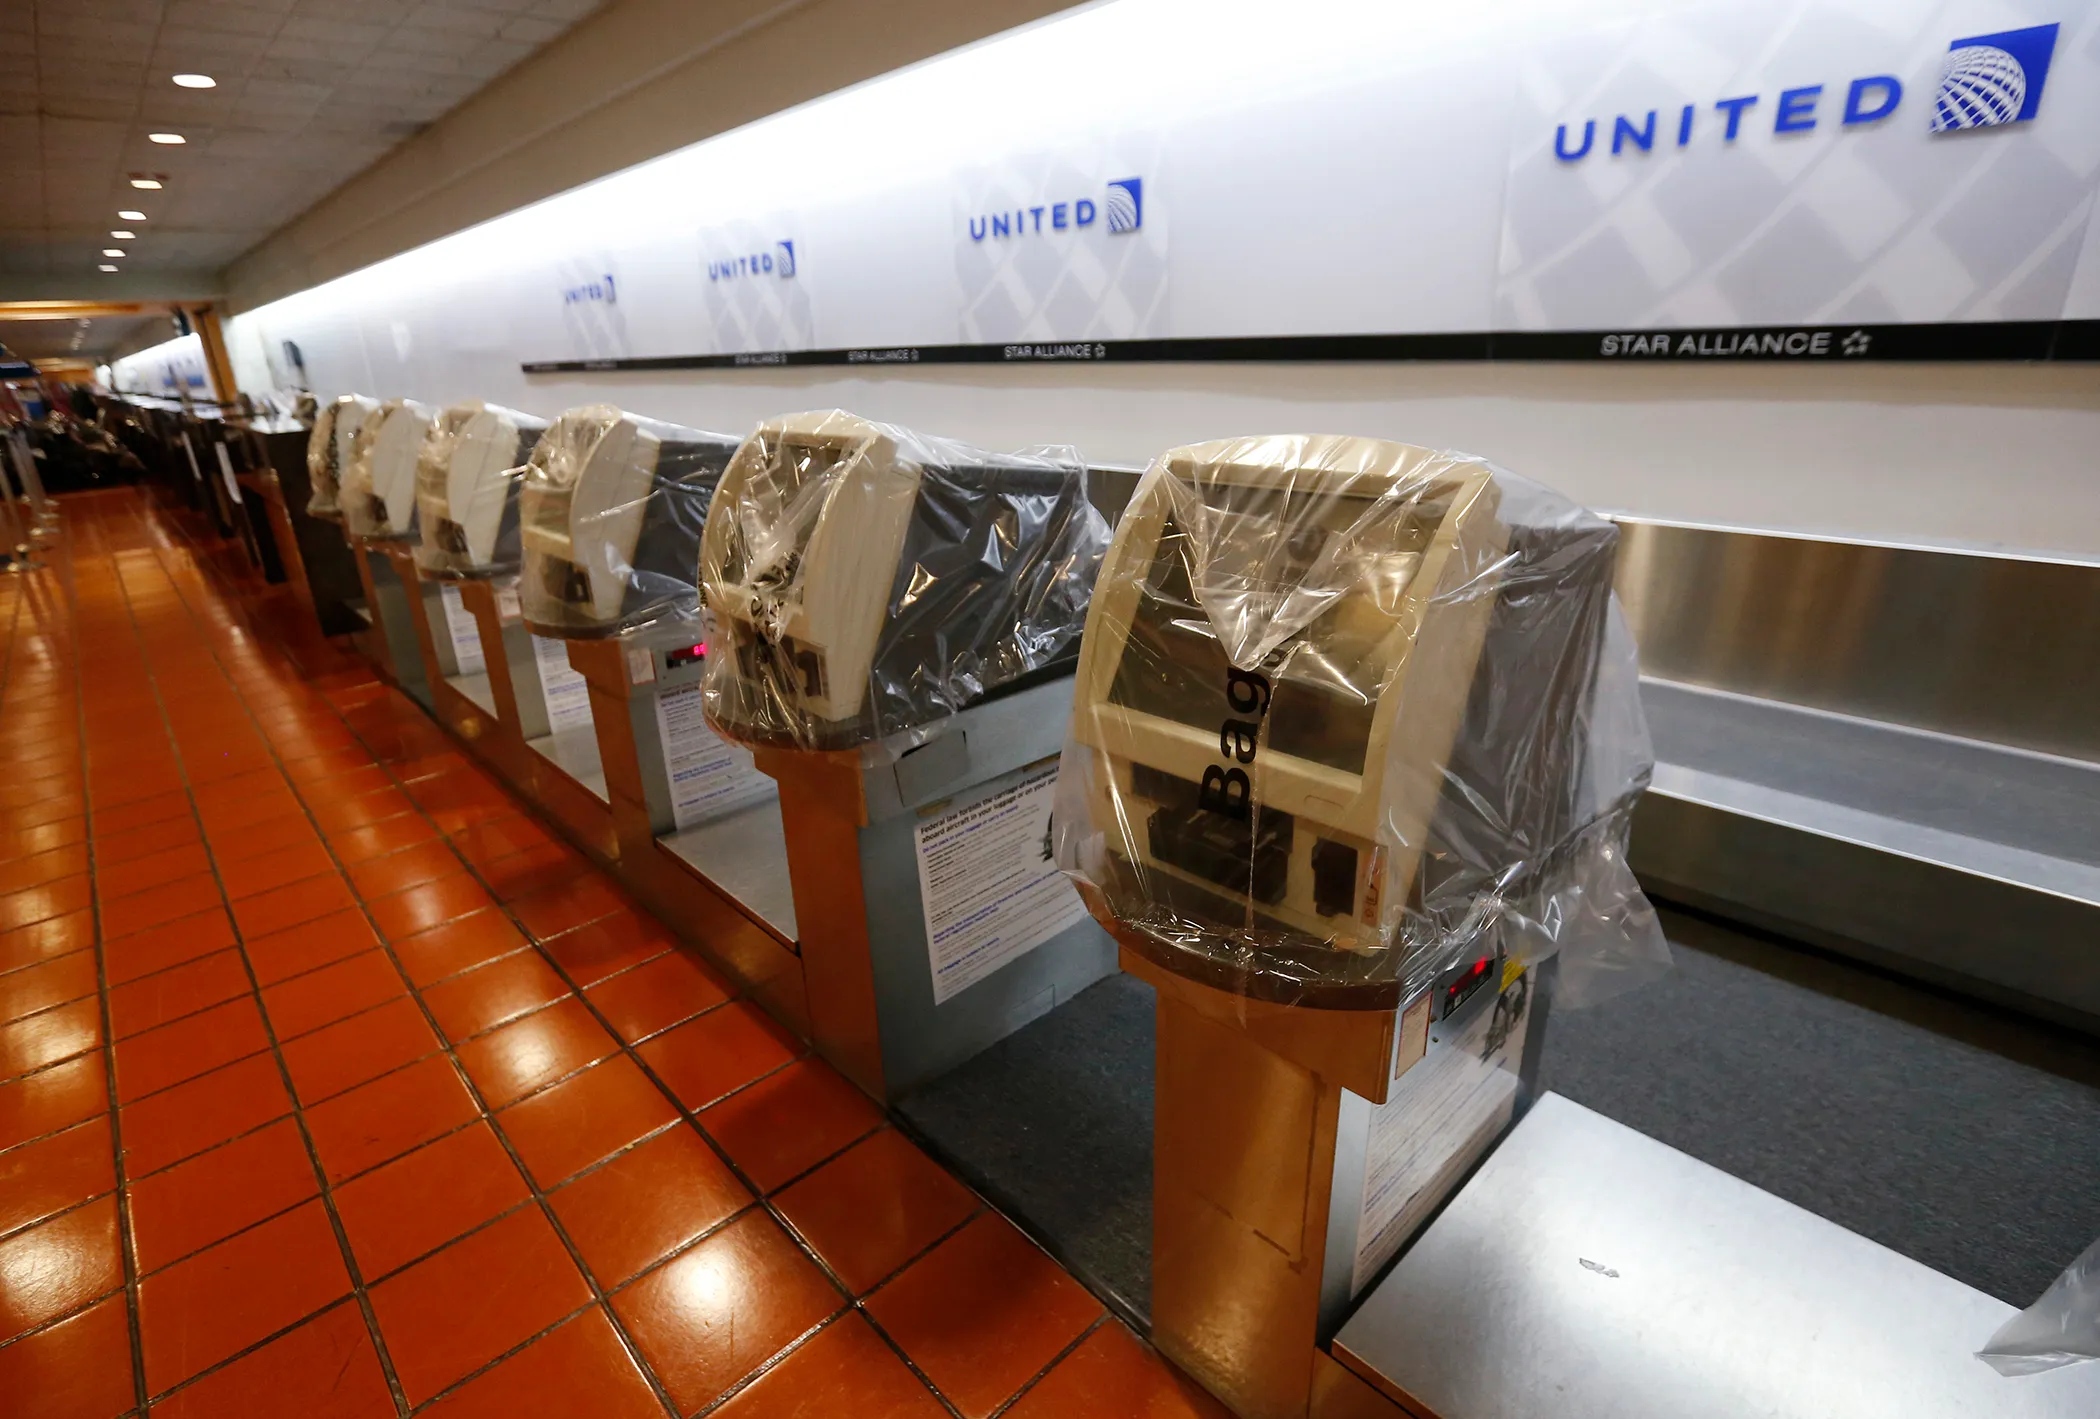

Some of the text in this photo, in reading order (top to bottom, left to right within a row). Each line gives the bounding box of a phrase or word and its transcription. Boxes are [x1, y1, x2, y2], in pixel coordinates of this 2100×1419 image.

[1554, 75, 1904, 162] UNITED
[970, 199, 1096, 241] UNITED
[708, 254, 774, 281] UNITED
[1003, 343, 1092, 359] STAR ALLIANCE
[1600, 332, 1832, 356] STAR ALLIANCE
[921, 817, 945, 834] Federal
[982, 797, 994, 806] the
[922, 827, 945, 843] aboard
[946, 816, 970, 832] aircraft
[978, 806, 992, 819] your
